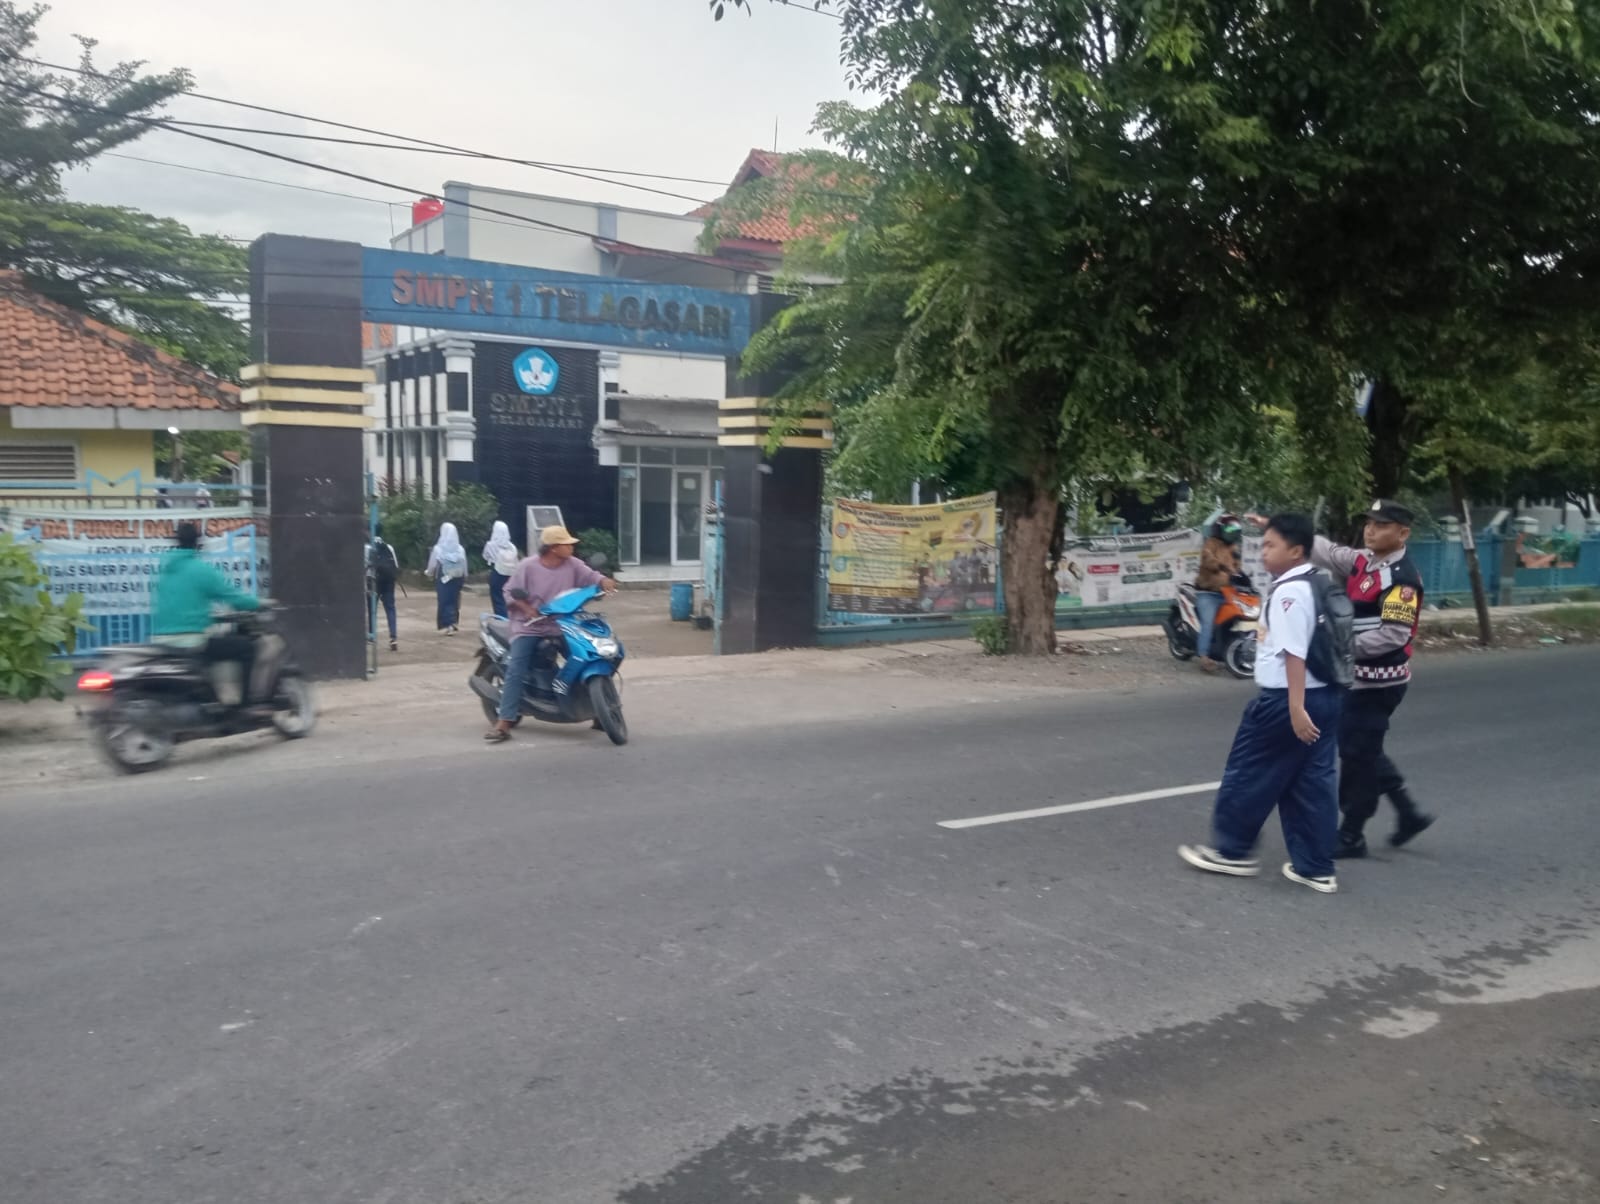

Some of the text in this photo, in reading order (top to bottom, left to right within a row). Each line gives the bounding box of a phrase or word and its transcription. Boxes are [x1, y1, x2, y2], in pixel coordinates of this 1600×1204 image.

[391, 269, 731, 340] SMPN 1 TELAGASARI
[73, 518, 140, 539] PUNGLI
